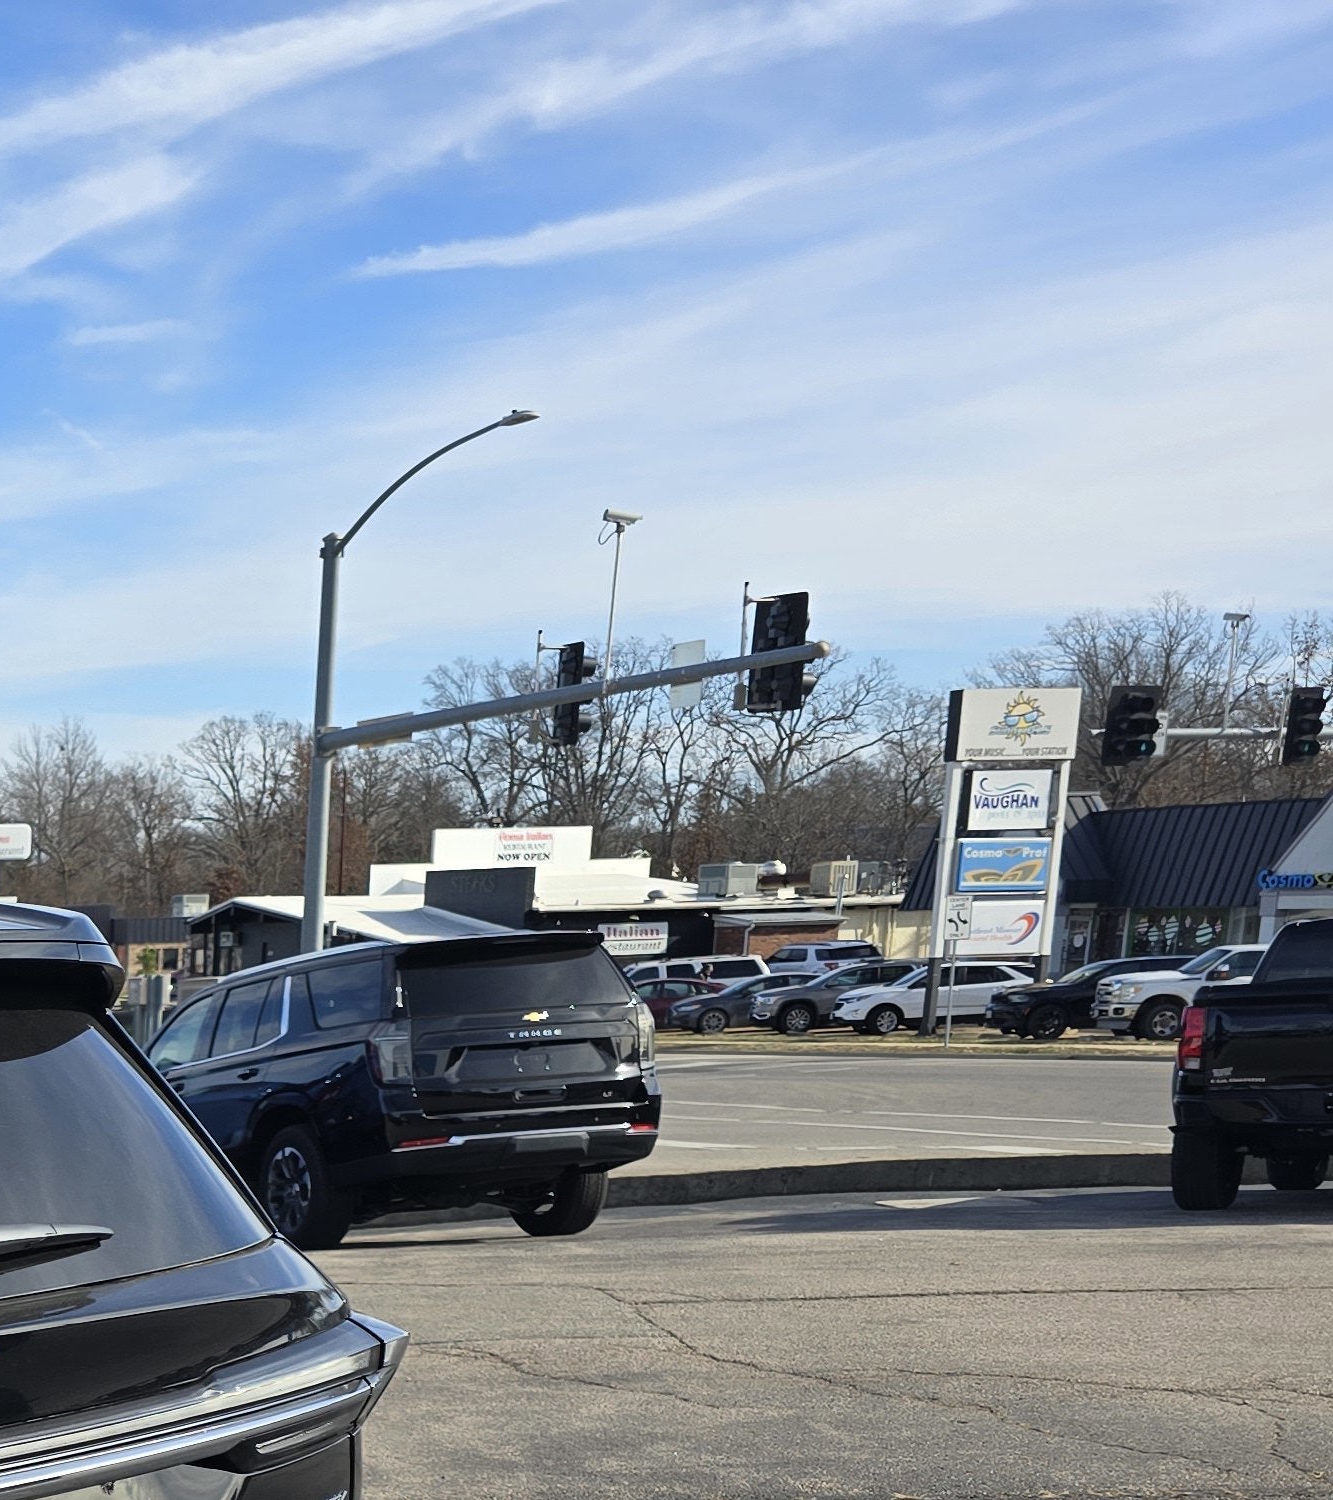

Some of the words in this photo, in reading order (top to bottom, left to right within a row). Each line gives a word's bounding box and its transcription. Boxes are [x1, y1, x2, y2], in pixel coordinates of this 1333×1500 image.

[974, 794, 1039, 809] VAUGHAN
[497, 853, 521, 861] NOW
[524, 852, 551, 861] OPEN
[965, 847, 1002, 859] Cosmo
[1022, 846, 1048, 858] Prof
[1257, 868, 1315, 889] Cosmo
